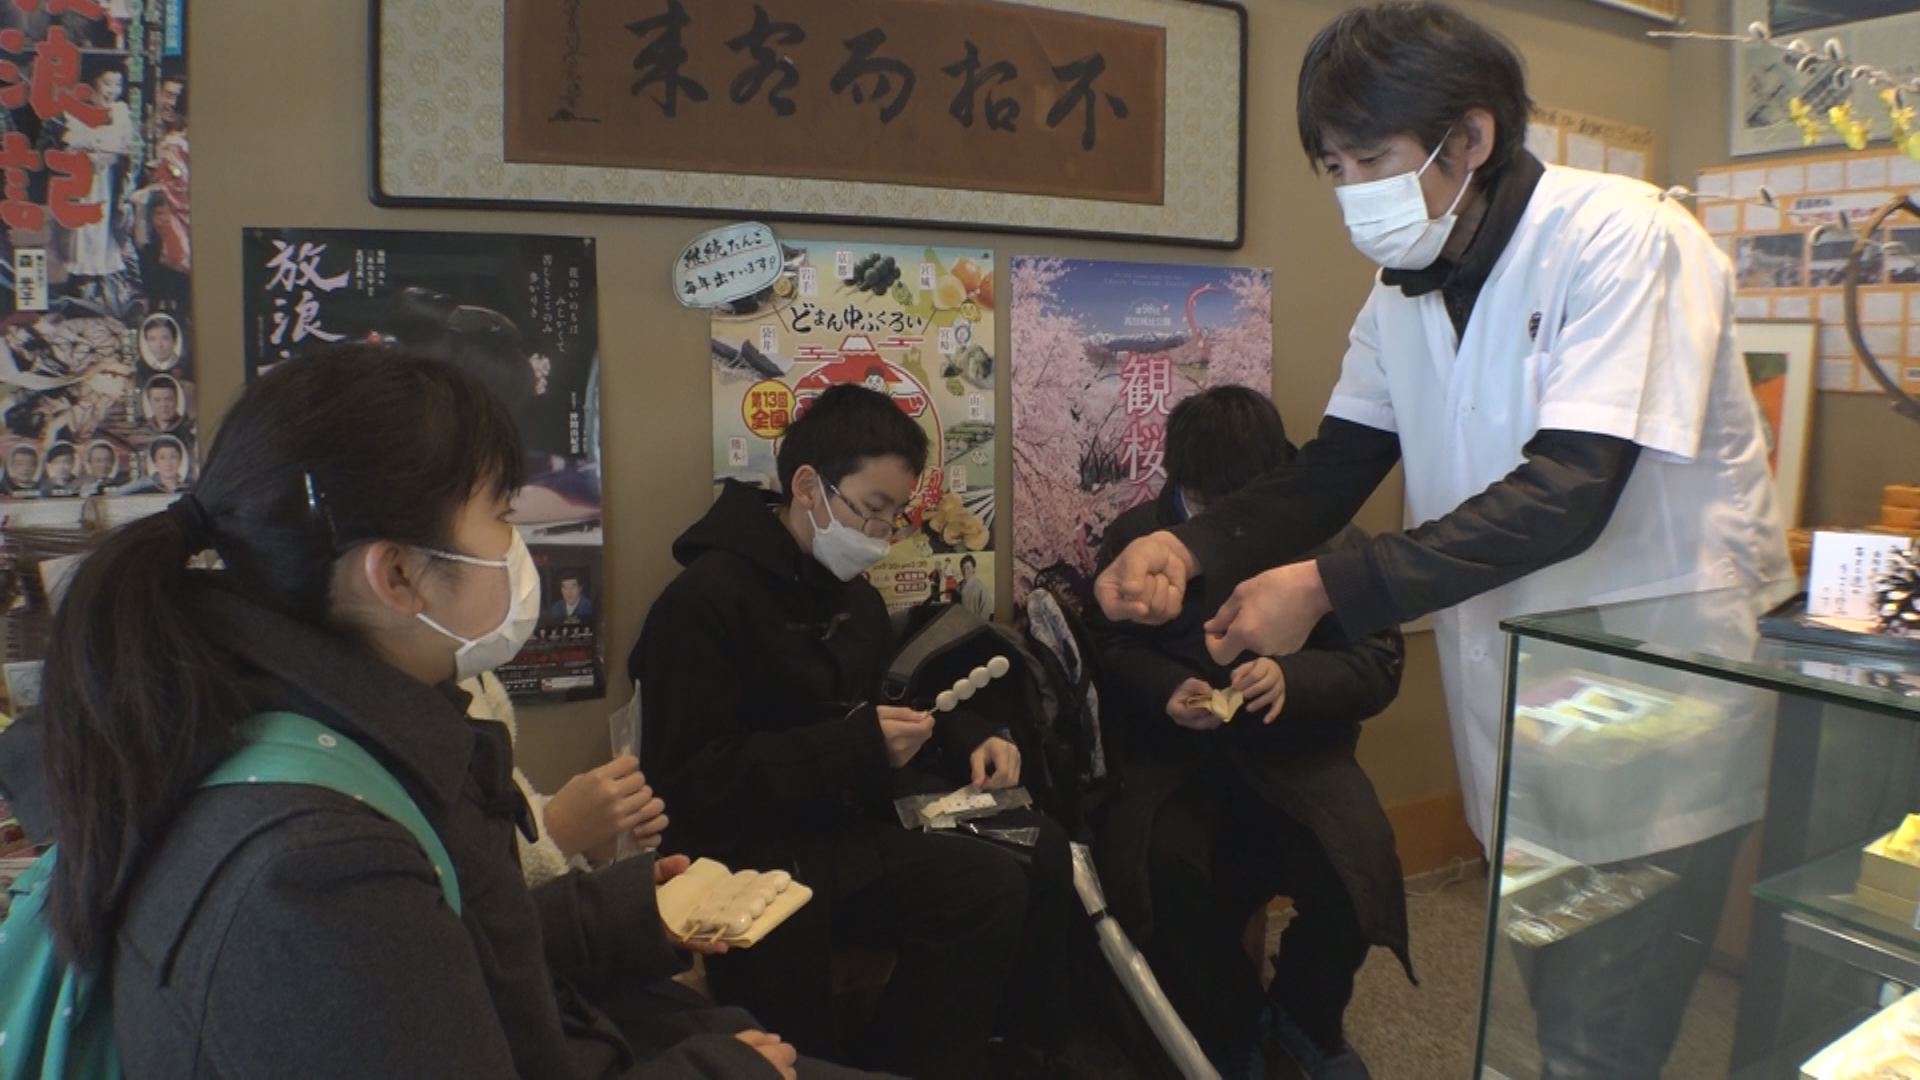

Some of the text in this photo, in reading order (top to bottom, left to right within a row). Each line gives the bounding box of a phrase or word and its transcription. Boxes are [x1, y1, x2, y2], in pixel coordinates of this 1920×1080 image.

[790, 302, 923, 334] どまん中ふくろい
[751, 390, 789, 409] 第13回
